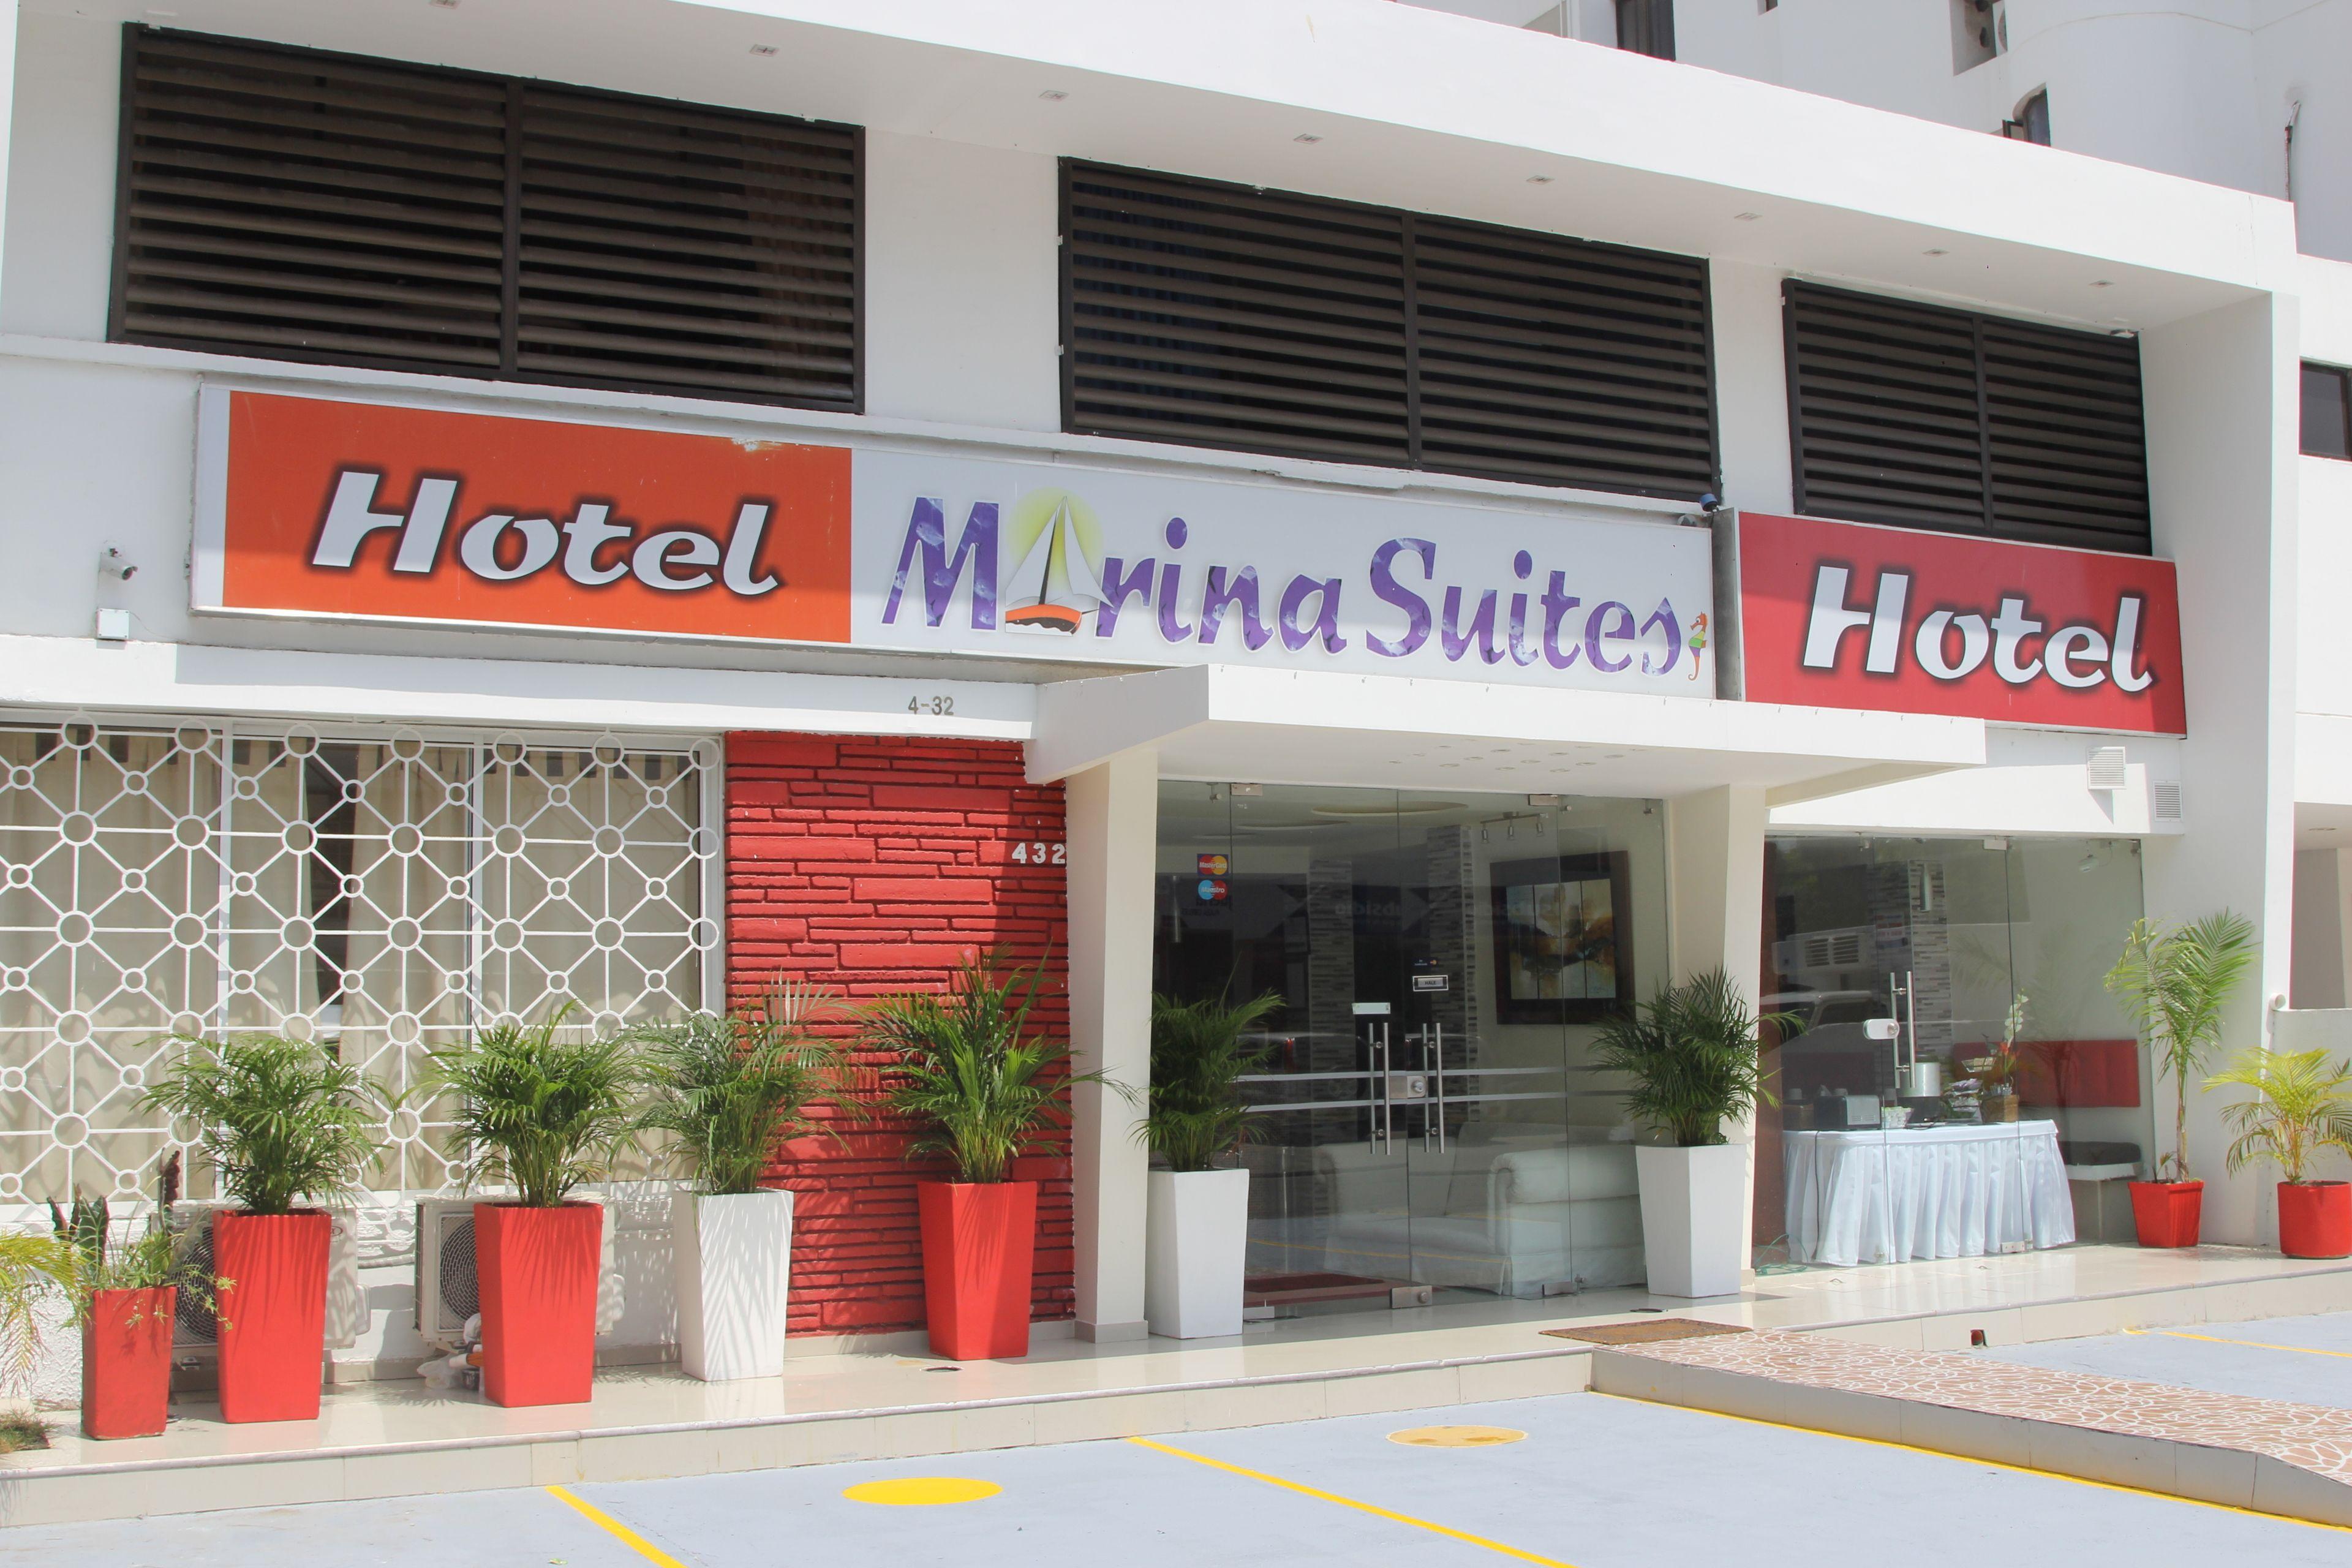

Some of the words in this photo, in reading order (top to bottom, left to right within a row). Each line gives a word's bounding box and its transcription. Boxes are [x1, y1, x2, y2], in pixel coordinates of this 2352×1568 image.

[313, 471, 778, 596] Hotel
[1365, 538, 1680, 677] Suites
[1803, 565, 2153, 692] Hotel
[908, 696, 954, 715] 4-32
[1012, 842, 1066, 864] 432
